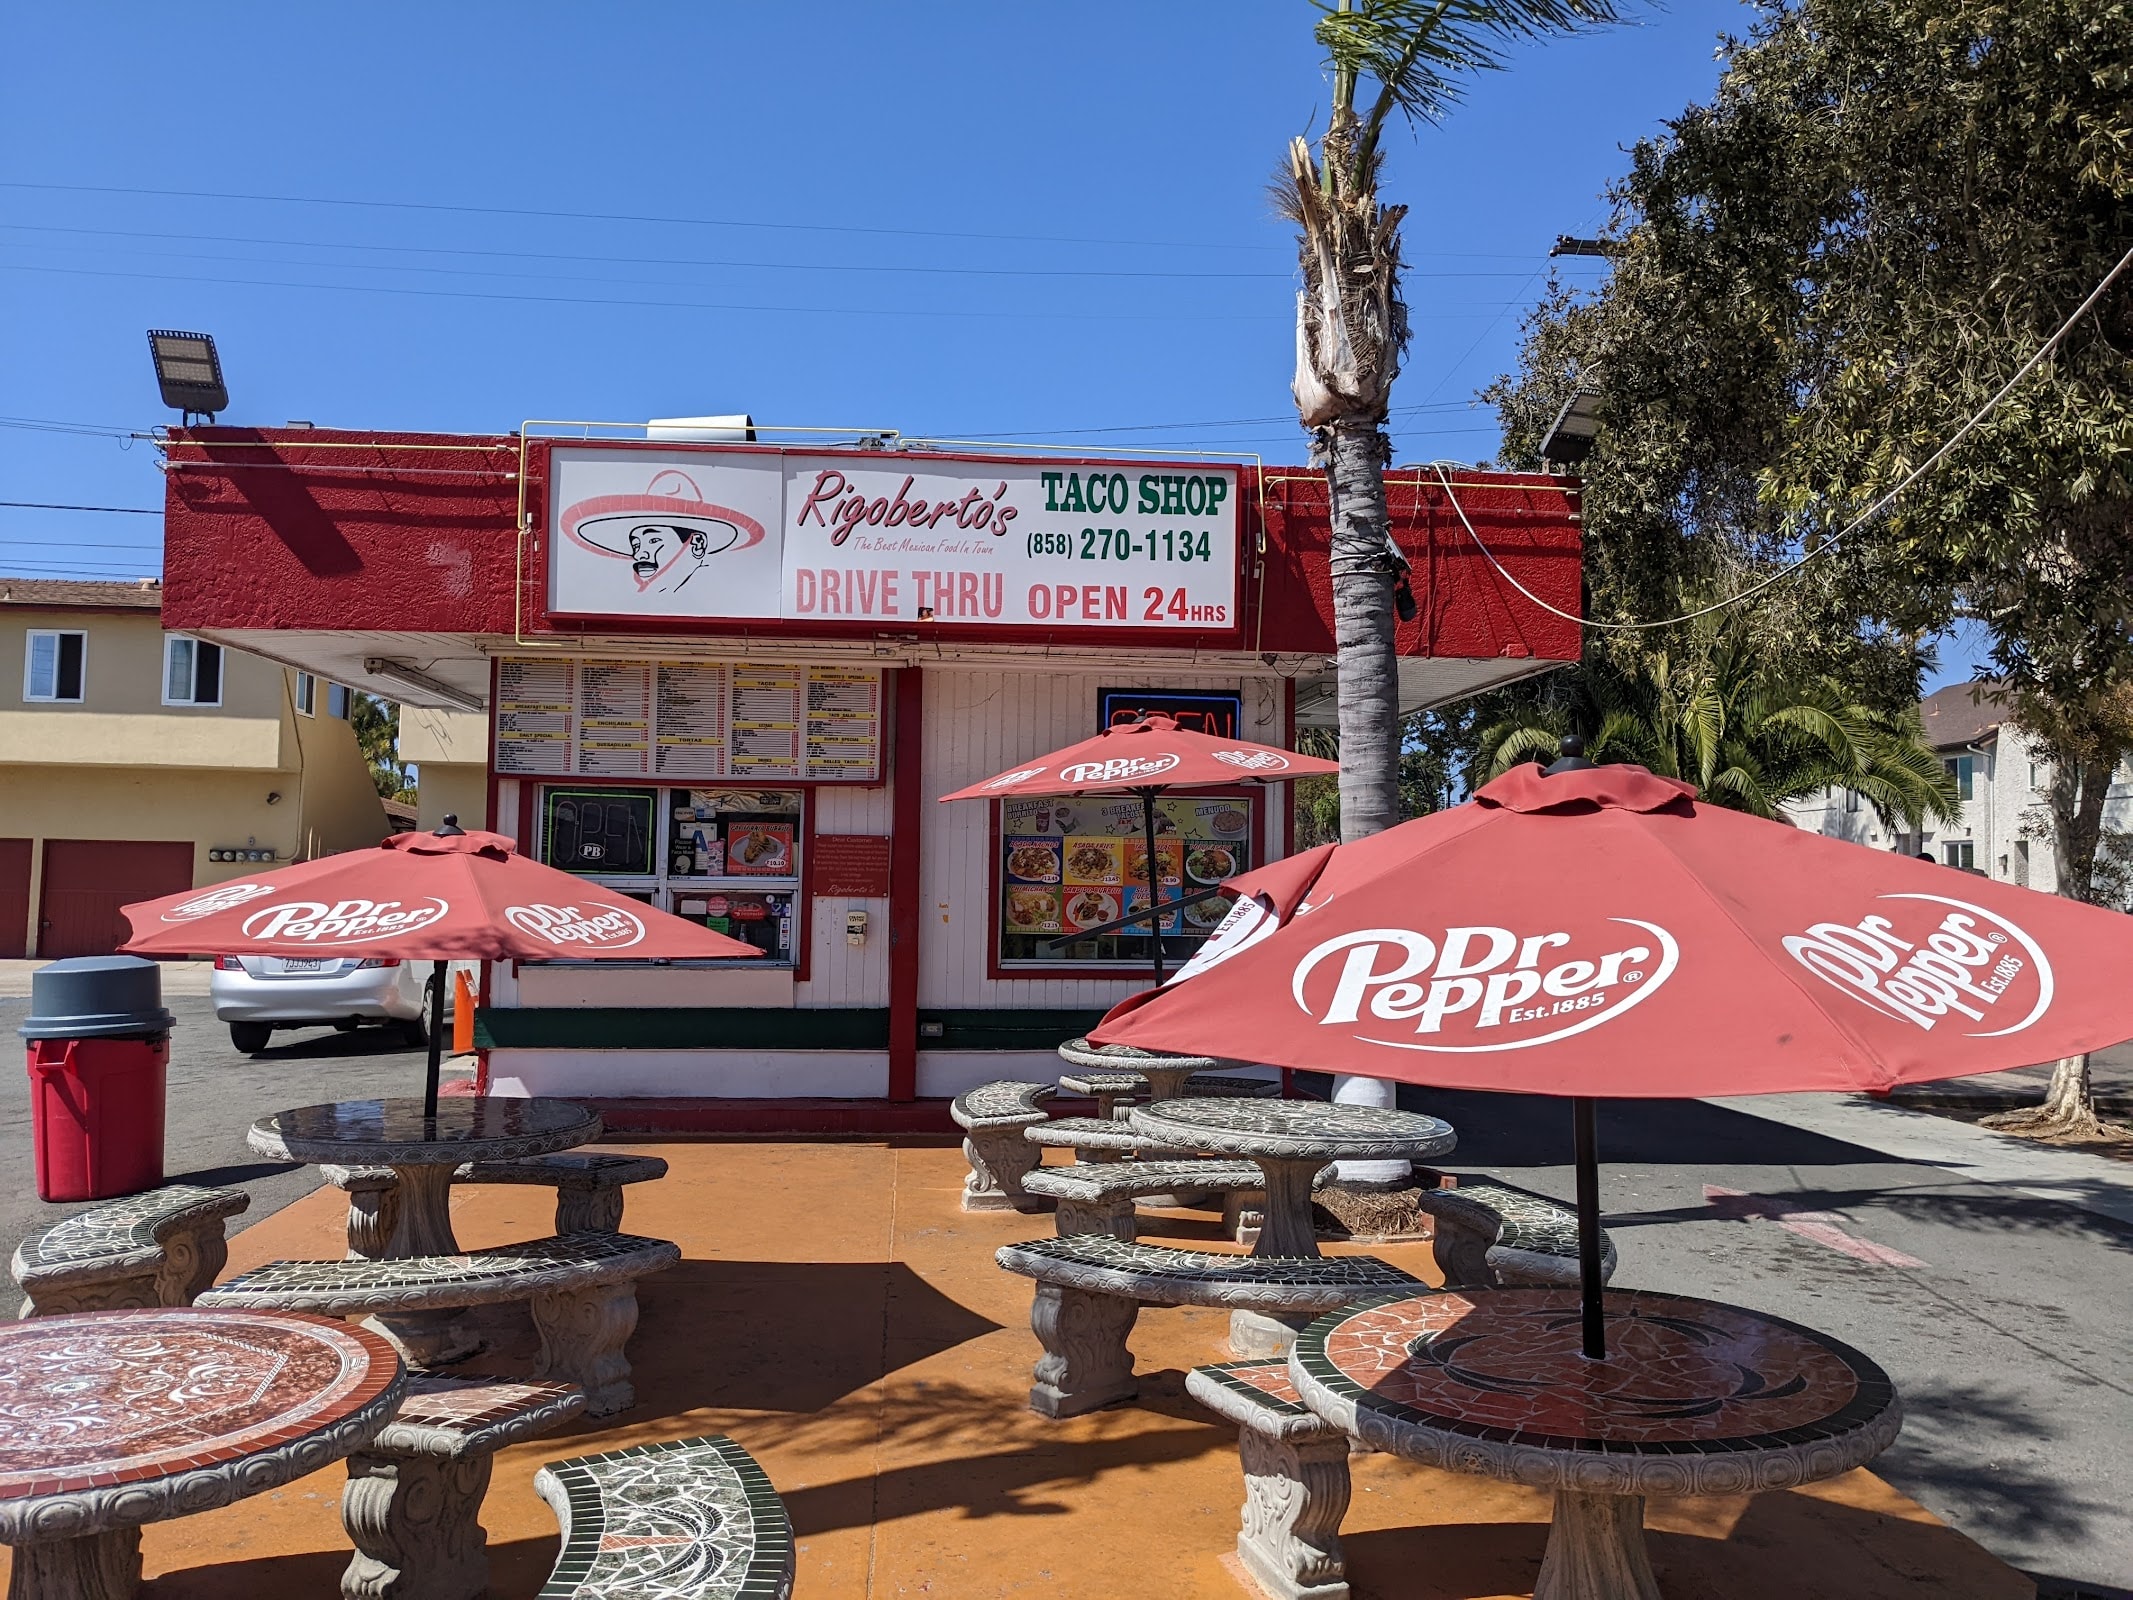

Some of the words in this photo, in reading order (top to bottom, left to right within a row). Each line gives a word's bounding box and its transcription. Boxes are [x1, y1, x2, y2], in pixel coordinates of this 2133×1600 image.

[796, 470, 1018, 546] Rigoberto's
[1041, 472, 1129, 514] TACO
[1138, 474, 1228, 516] SHOP
[854, 536, 872, 551] The
[874, 538, 898, 552] Best
[898, 538, 936, 553] Mexican
[938, 539, 958, 554] Food
[958, 540, 968, 554] In
[972, 540, 994, 555] Town
[1027, 533, 1073, 559] (858)
[1080, 528, 1210, 562] 270-1134
[796, 568, 899, 615] DRIVE
[912, 570, 1003, 618] THRU
[1028, 584, 1127, 620] OPEN
[1060, 758, 1171, 782] Pepper
[1105, 757, 1146, 770] Dr
[1006, 799, 1054, 813] BREAKFAST
[1007, 810, 1038, 820] BURRITO
[1101, 808, 1108, 816] 3
[1117, 810, 1139, 819] TACOS
[1195, 804, 1230, 816] MENUDO
[583, 846, 601, 857] PB
[692, 829, 708, 852] A
[242, 902, 435, 940] Pepper
[325, 900, 402, 921] Dr
[505, 906, 626, 945] Pepper
[529, 903, 584, 925] Dr
[1432, 926, 1571, 979] Dr
[1804, 914, 1914, 974] Dr
[1293, 928, 1650, 1034] Pepper
[1781, 912, 1998, 1032] Pepper
[1980, 954, 2024, 996] Est.1885
[1508, 992, 1606, 1024] Est.1885
